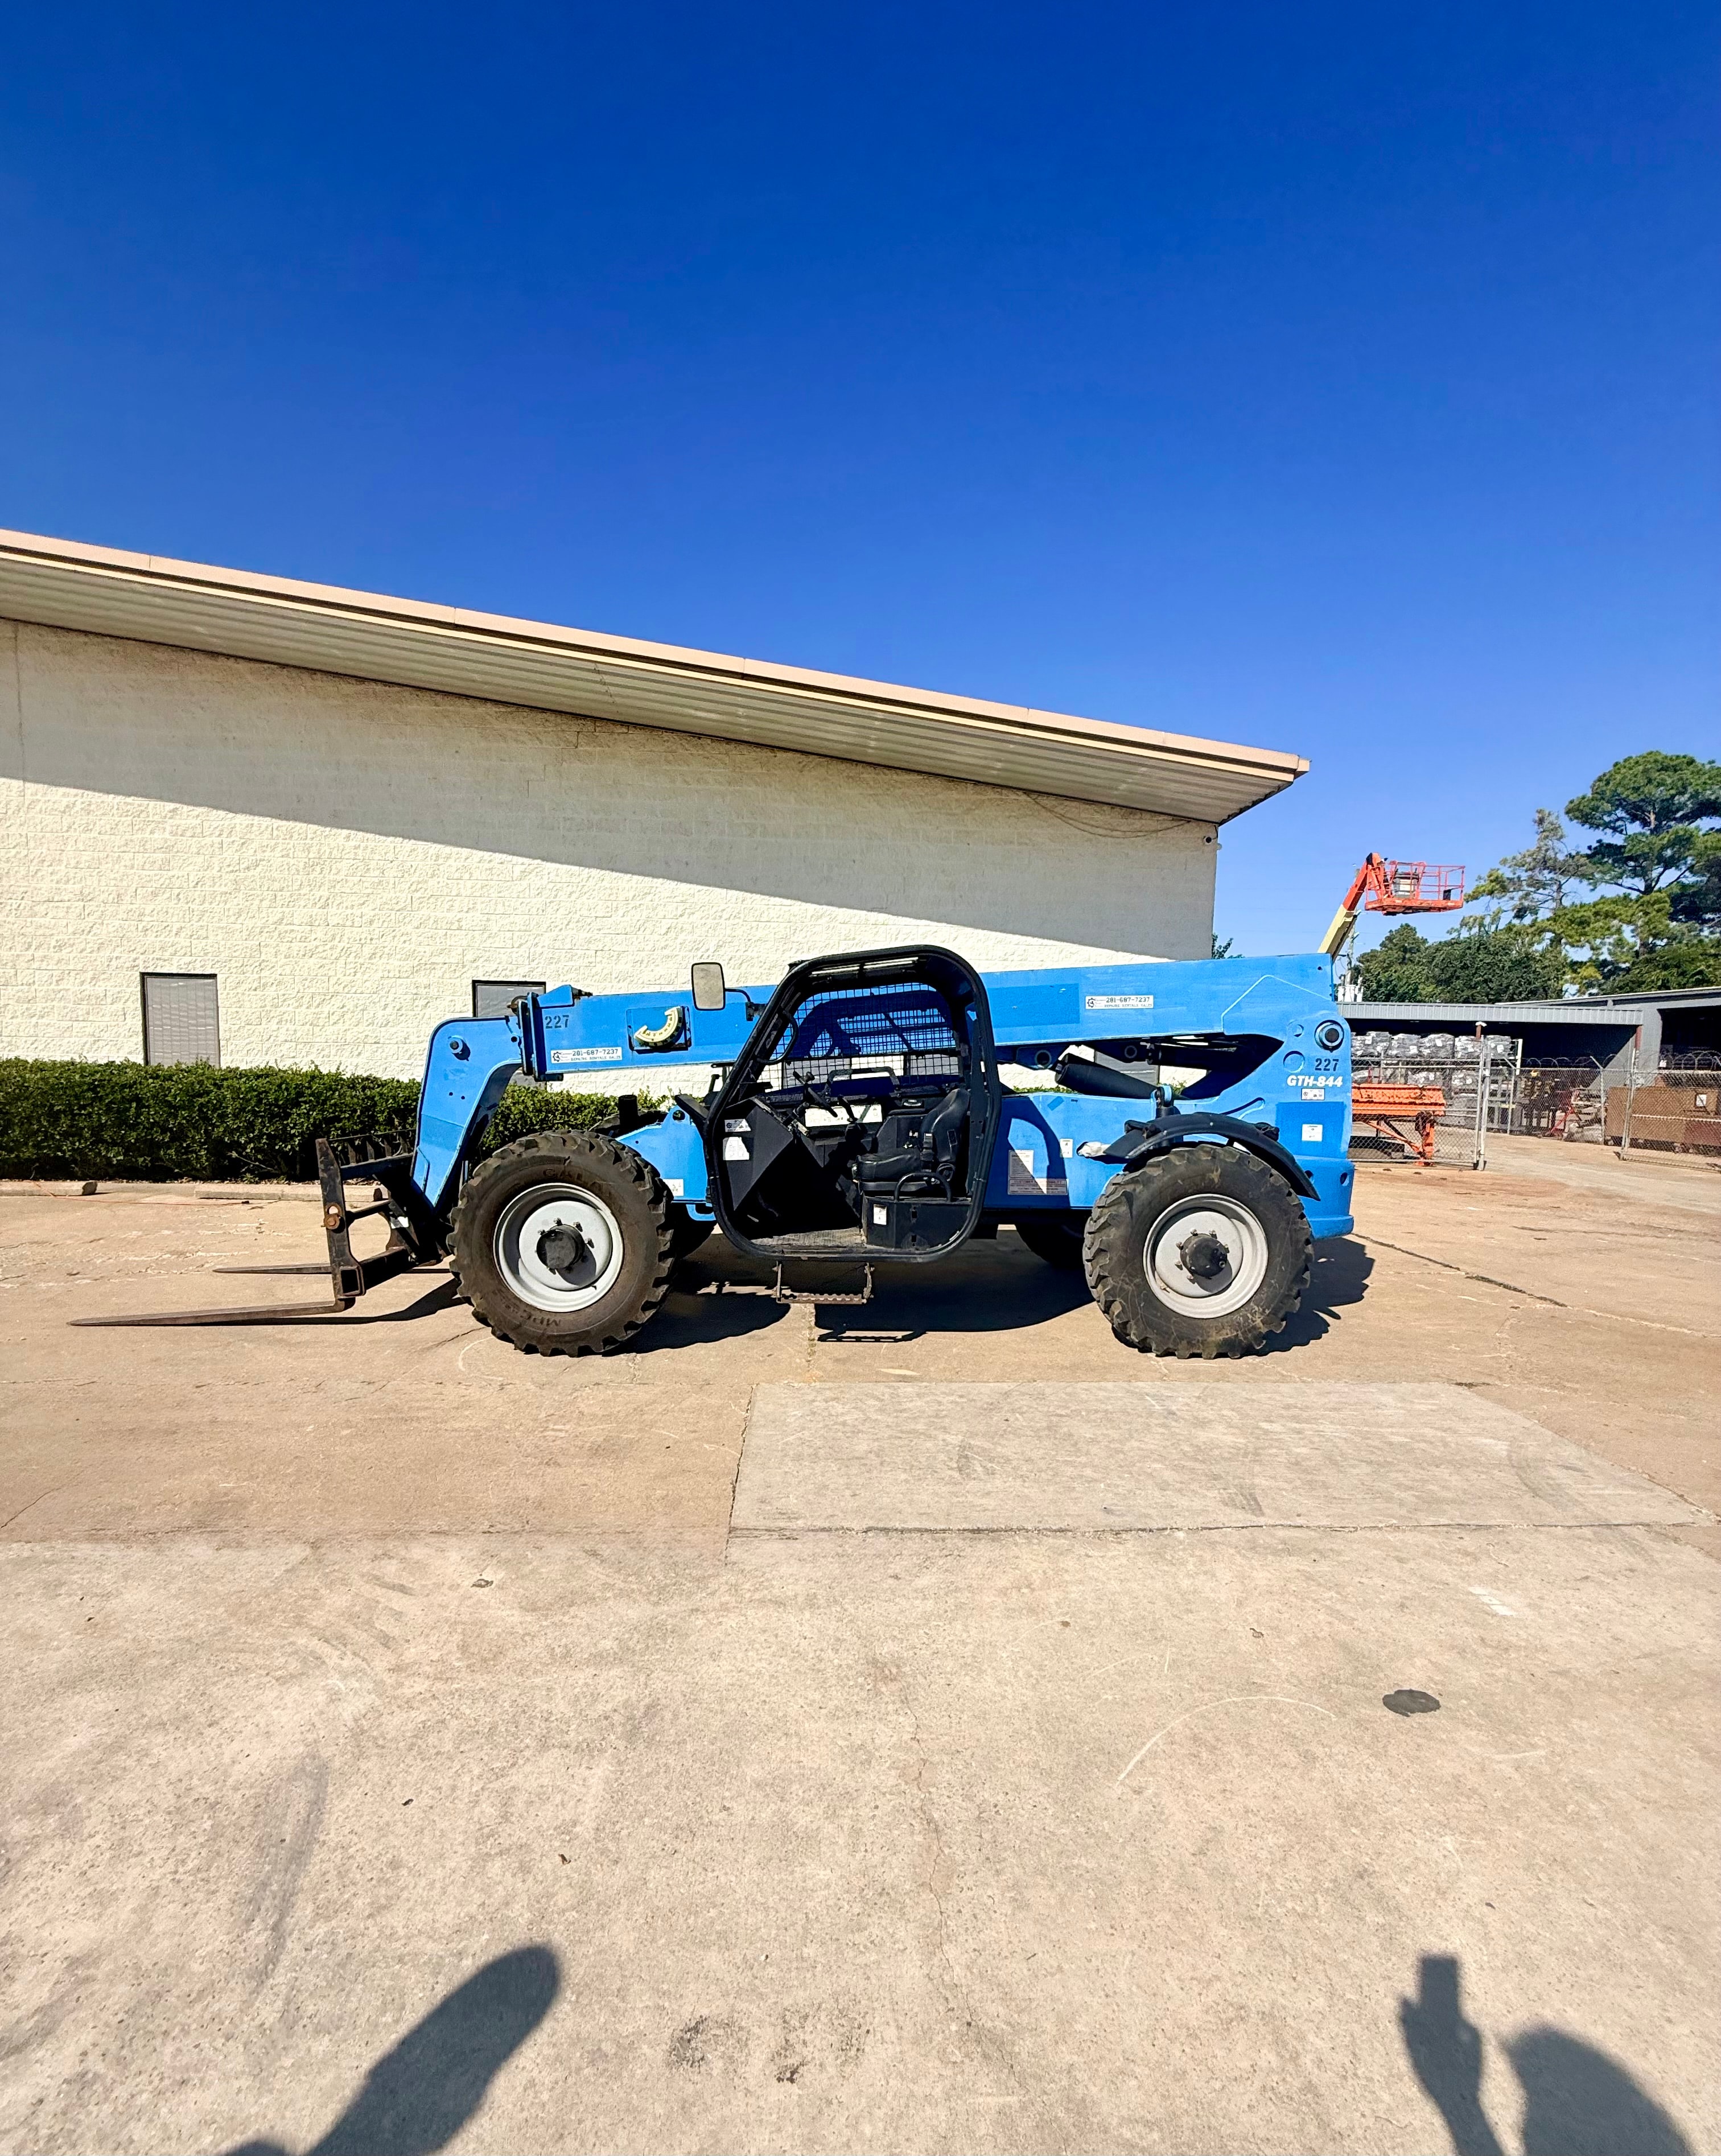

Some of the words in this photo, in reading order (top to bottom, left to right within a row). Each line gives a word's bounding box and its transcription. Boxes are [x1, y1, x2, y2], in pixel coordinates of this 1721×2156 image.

[545, 1015, 569, 1029] 227
[1315, 1058, 1339, 1071] 227
[1287, 1075, 1343, 1087] GTH-844
